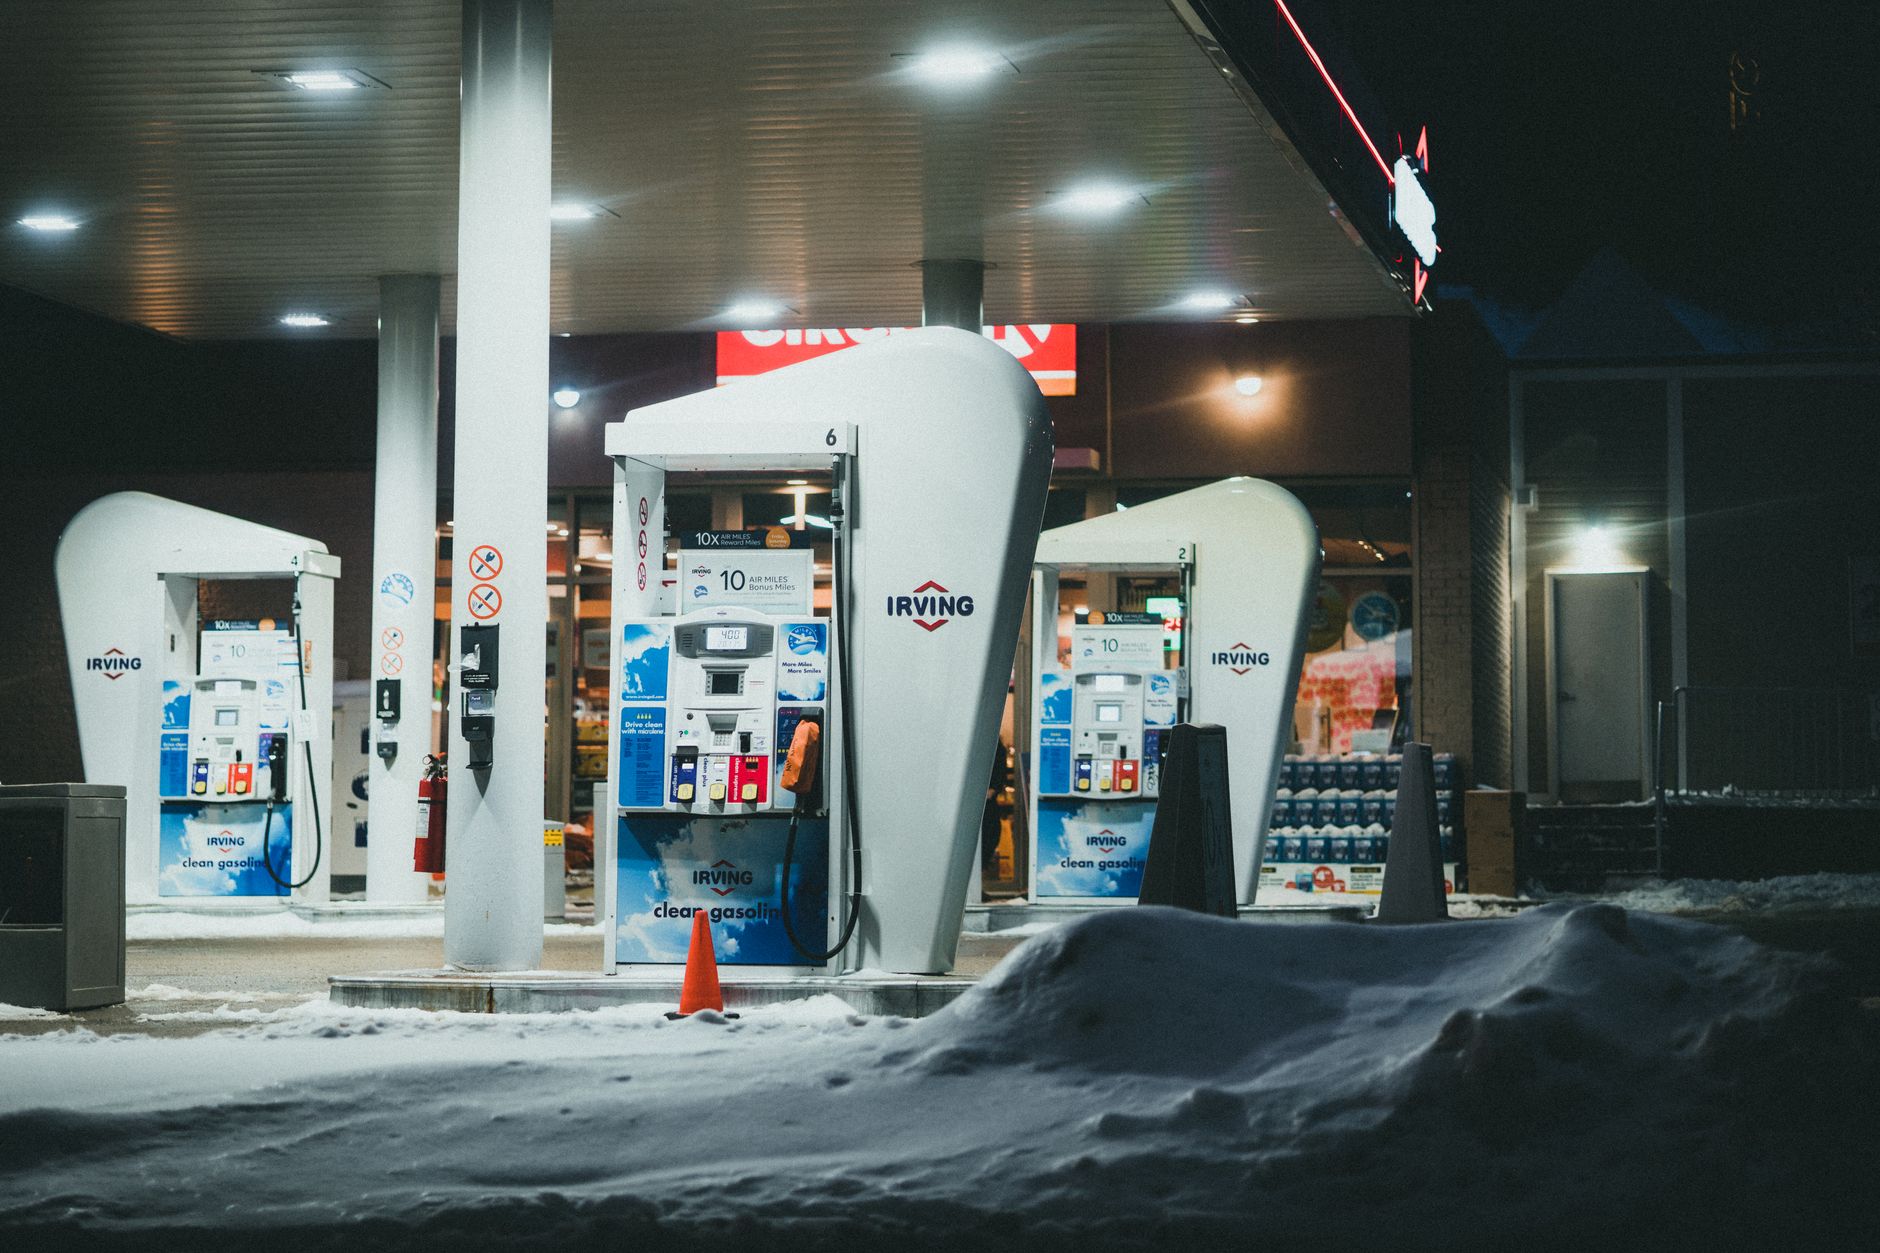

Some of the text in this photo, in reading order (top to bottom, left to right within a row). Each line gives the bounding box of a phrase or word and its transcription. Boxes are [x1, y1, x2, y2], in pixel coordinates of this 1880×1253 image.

[826, 428, 837, 446] 6
[291, 555, 298, 565] 4
[1179, 548, 1186, 559] 2
[720, 570, 745, 591] 10
[887, 596, 974, 617] IRVING
[231, 644, 246, 658] 10
[1101, 639, 1118, 652] 10
[87, 657, 142, 670] IRVING
[1212, 652, 1270, 665] IRVING
[207, 836, 245, 846] IRVING
[1086, 836, 1127, 846] IRVING
[182, 857, 214, 868] clean
[1061, 857, 1094, 868] clean
[692, 870, 753, 885] IRVING
[710, 902, 781, 923] gasolin
